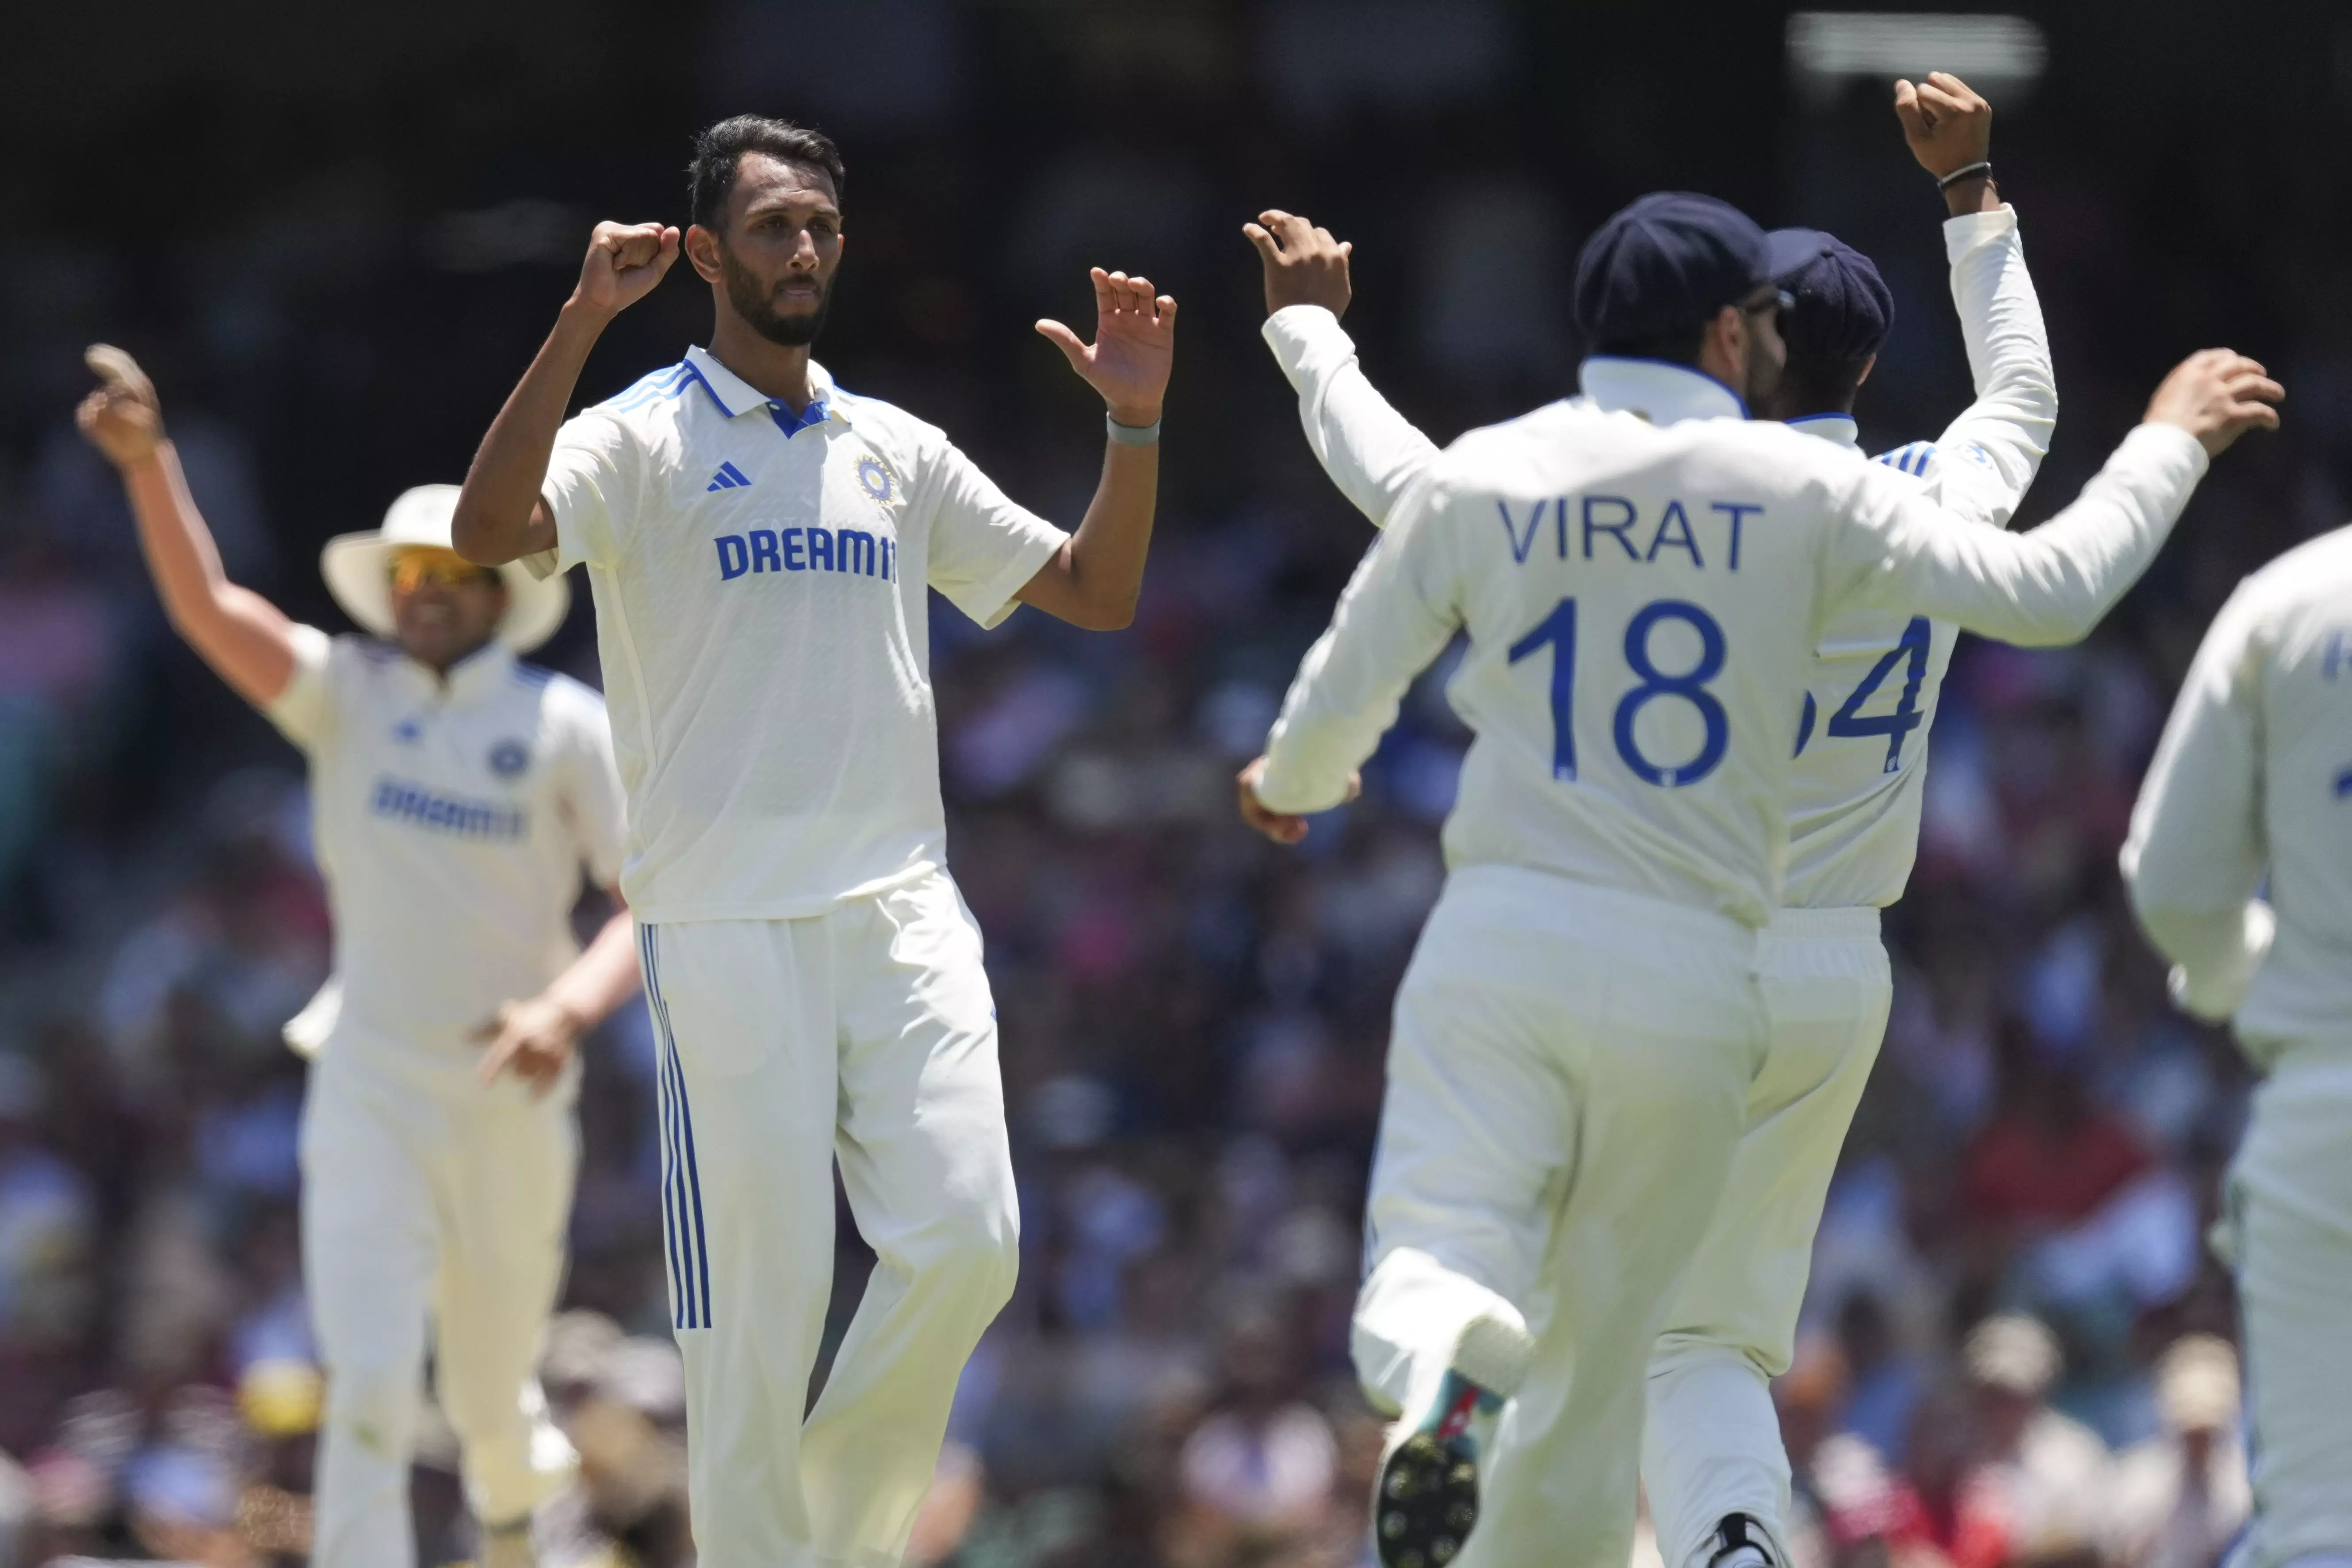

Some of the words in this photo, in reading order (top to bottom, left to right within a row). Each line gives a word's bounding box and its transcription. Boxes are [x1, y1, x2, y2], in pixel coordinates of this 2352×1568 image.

[1497, 496, 1765, 572] VIRAT
[1508, 597, 1729, 788] 18
[1792, 614, 1931, 774] 4
